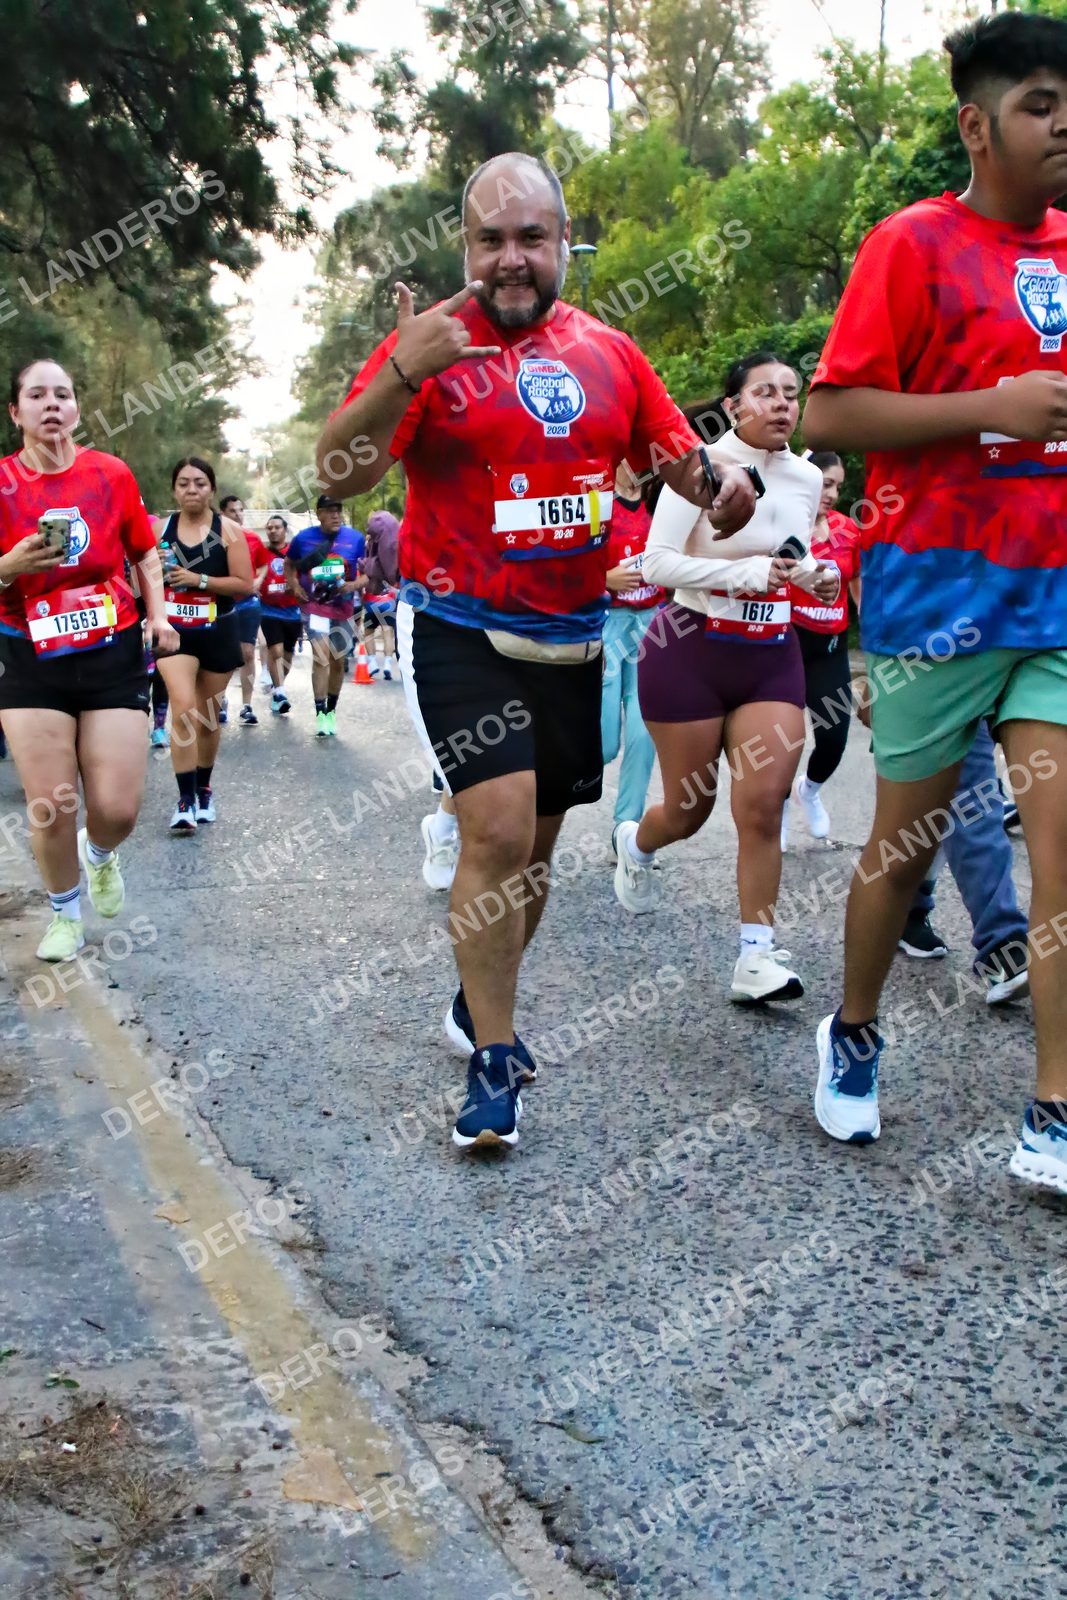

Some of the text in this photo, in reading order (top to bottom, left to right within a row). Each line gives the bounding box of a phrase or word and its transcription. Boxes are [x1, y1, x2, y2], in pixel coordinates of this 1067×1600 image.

[1029, 277, 1060, 293] Global
[1026, 290, 1050, 306] Race
[1042, 338, 1060, 349] 2026
[531, 376, 565, 388] Global
[528, 386, 555, 397] Race
[546, 425, 567, 434] 2026
[538, 496, 585, 526] 1664
[553, 528, 574, 540] 20-26
[176, 604, 199, 616] 3481
[742, 602, 774, 622] 1612
[793, 605, 844, 620] SANTIAGO
[53, 609, 99, 634] 17563
